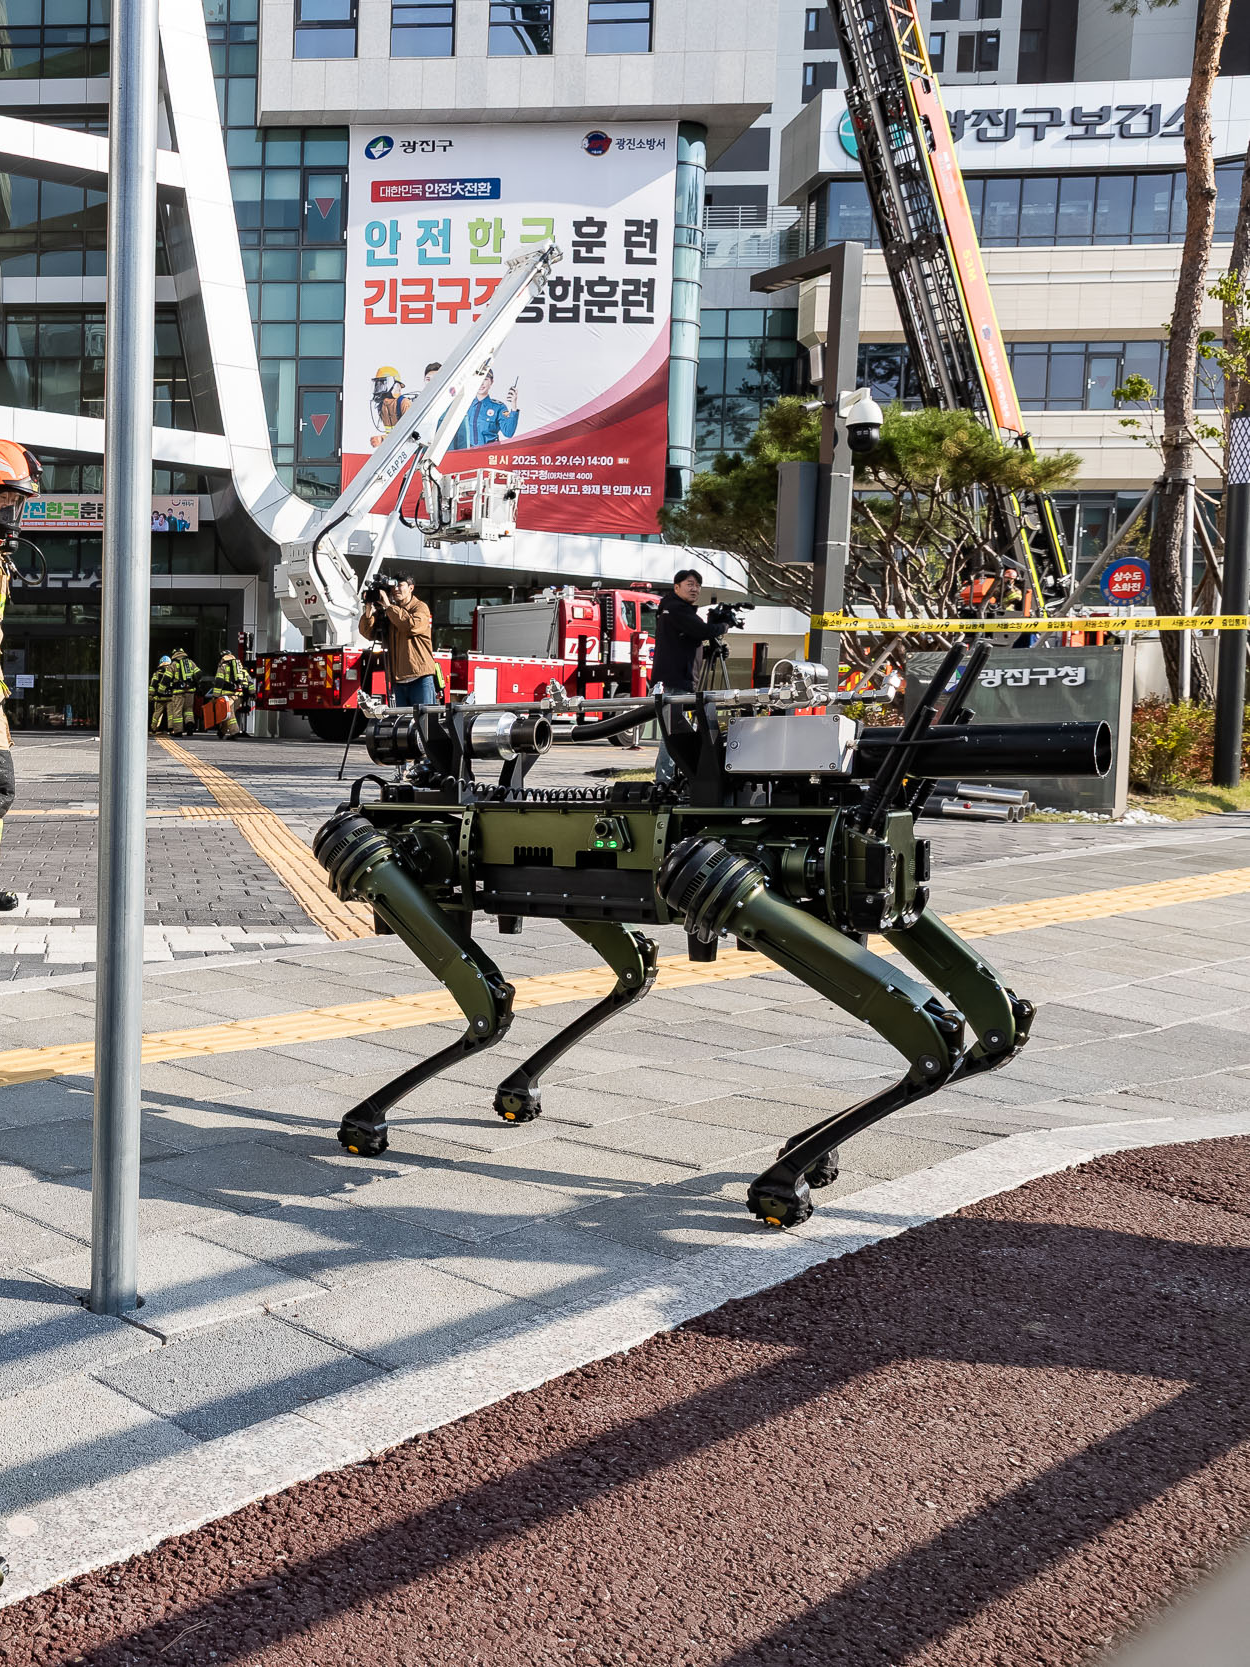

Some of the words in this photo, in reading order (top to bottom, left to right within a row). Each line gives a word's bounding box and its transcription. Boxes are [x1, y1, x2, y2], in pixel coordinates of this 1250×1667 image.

[399, 139, 454, 154] 광진구
[615, 137, 666, 151] 광진소방서
[379, 184, 423, 198] 대한민국
[425, 181, 492, 198] 안전大전환
[387, 451, 408, 478] EAP28
[512, 455, 539, 466] 2025.
[540, 455, 554, 466] 10.
[587, 455, 614, 466] 14:00
[582, 485, 600, 495] 화재
[602, 485, 611, 495] 및
[613, 485, 631, 496] 인파
[633, 486, 652, 497] 사고
[1112, 571, 1142, 582] 상수도
[1111, 582, 1141, 592] 소화전
[304, 594, 318, 605] 119
[936, 621, 950, 629] 119
[1025, 621, 1039, 629] 119
[1112, 619, 1127, 627] 119
[1200, 618, 1214, 626] 119
[569, 638, 597, 655] 19
[977, 665, 1086, 688] 광진구청
